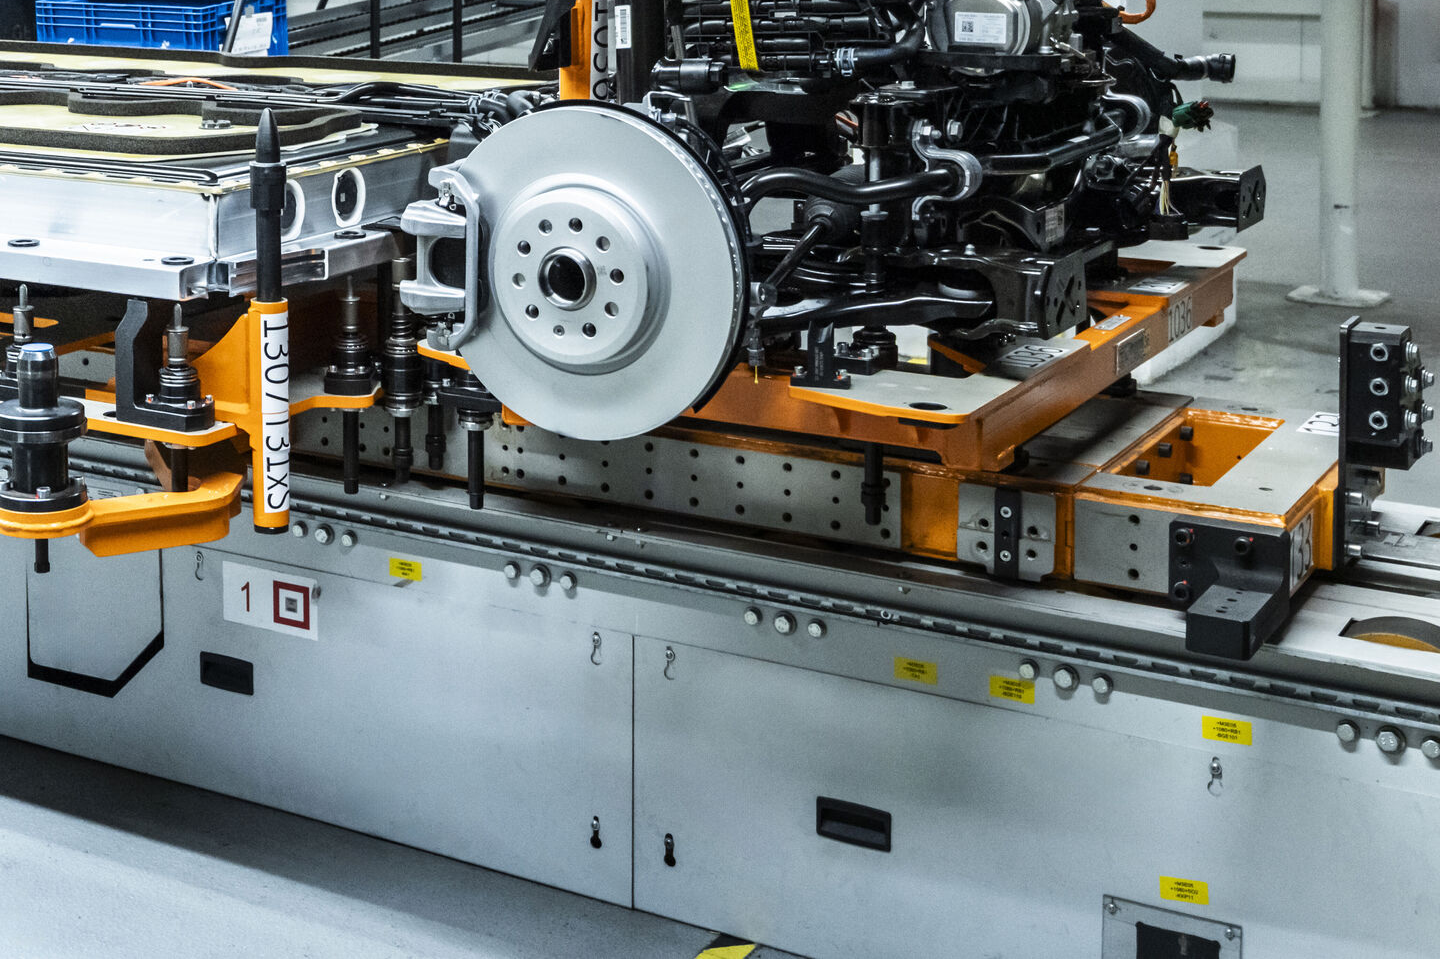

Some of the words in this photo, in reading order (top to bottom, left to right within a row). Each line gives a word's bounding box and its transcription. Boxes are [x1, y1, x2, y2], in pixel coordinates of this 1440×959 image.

[1166, 295, 1193, 344] 1036
[999, 344, 1064, 369] 1036
[241, 581, 250, 612] 1
